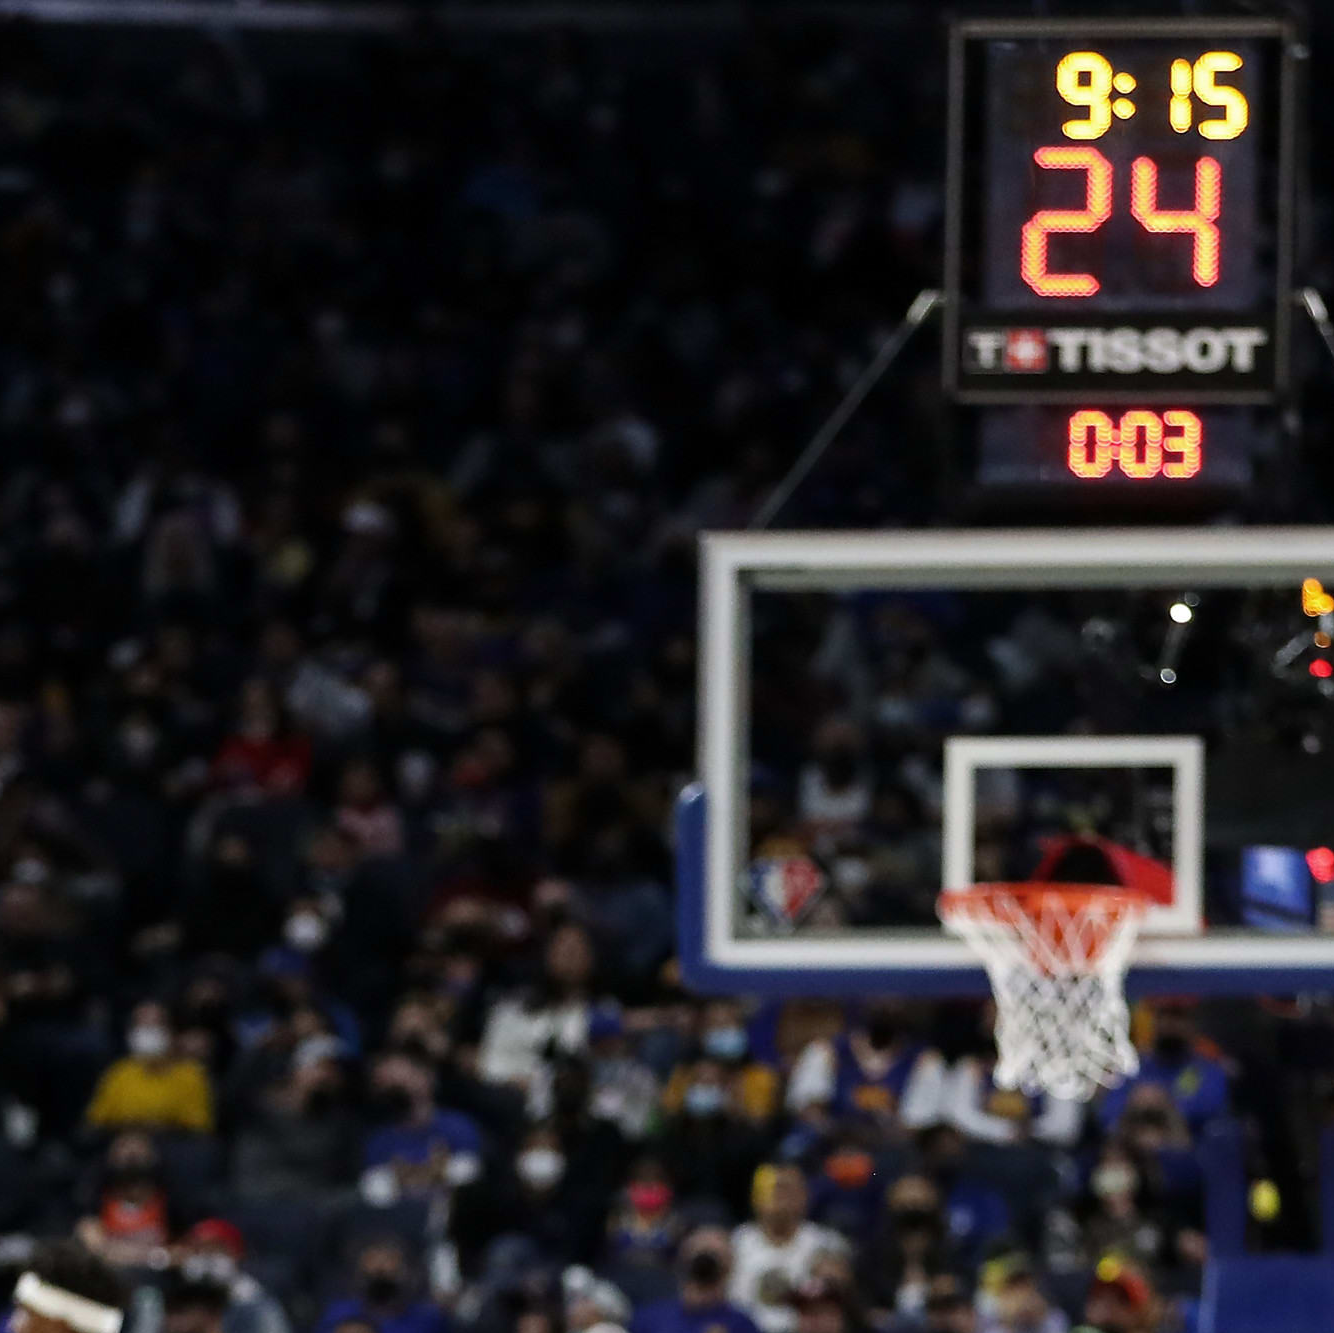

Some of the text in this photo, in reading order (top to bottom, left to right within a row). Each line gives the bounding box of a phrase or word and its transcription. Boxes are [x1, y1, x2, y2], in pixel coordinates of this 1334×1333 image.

[1056, 50, 1249, 140] 9:15
[1020, 146, 1224, 297] 24
[1046, 327, 1267, 374] TISSOT
